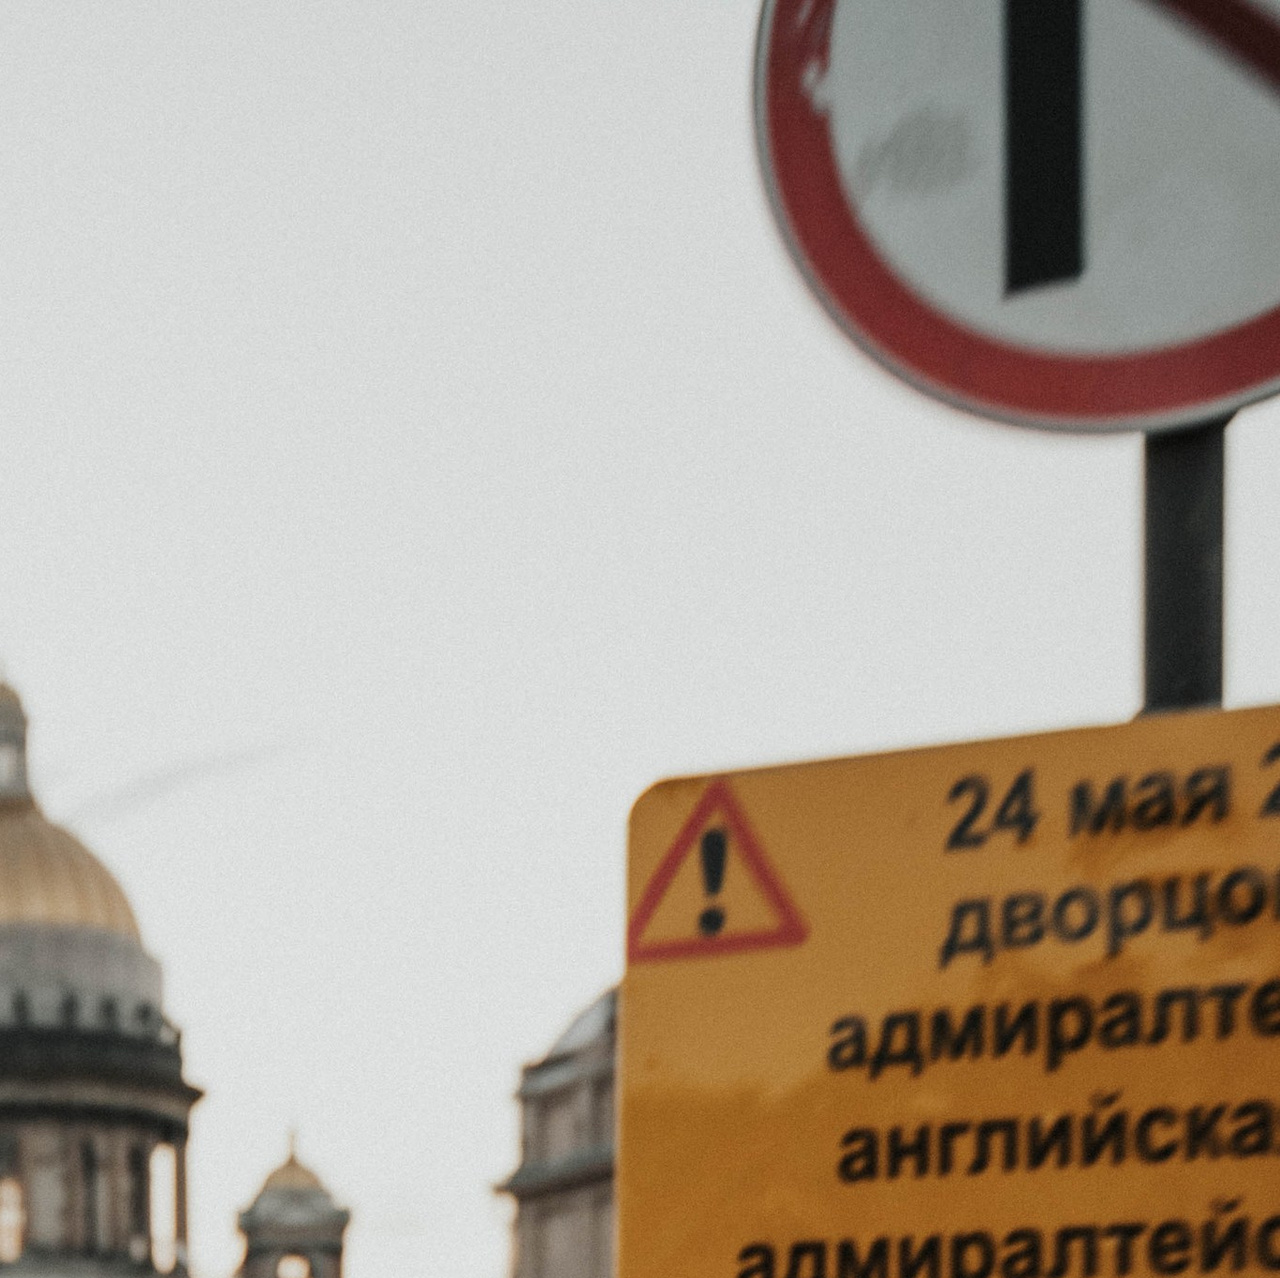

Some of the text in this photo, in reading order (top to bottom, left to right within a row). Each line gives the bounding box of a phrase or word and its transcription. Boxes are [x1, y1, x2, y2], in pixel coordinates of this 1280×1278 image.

[946, 768, 1039, 852] 24
[1069, 764, 1232, 838] мая
[939, 866, 1280, 969] дворцо
[827, 976, 1280, 1081] адмиралте
[836, 1090, 1280, 1185] английска
